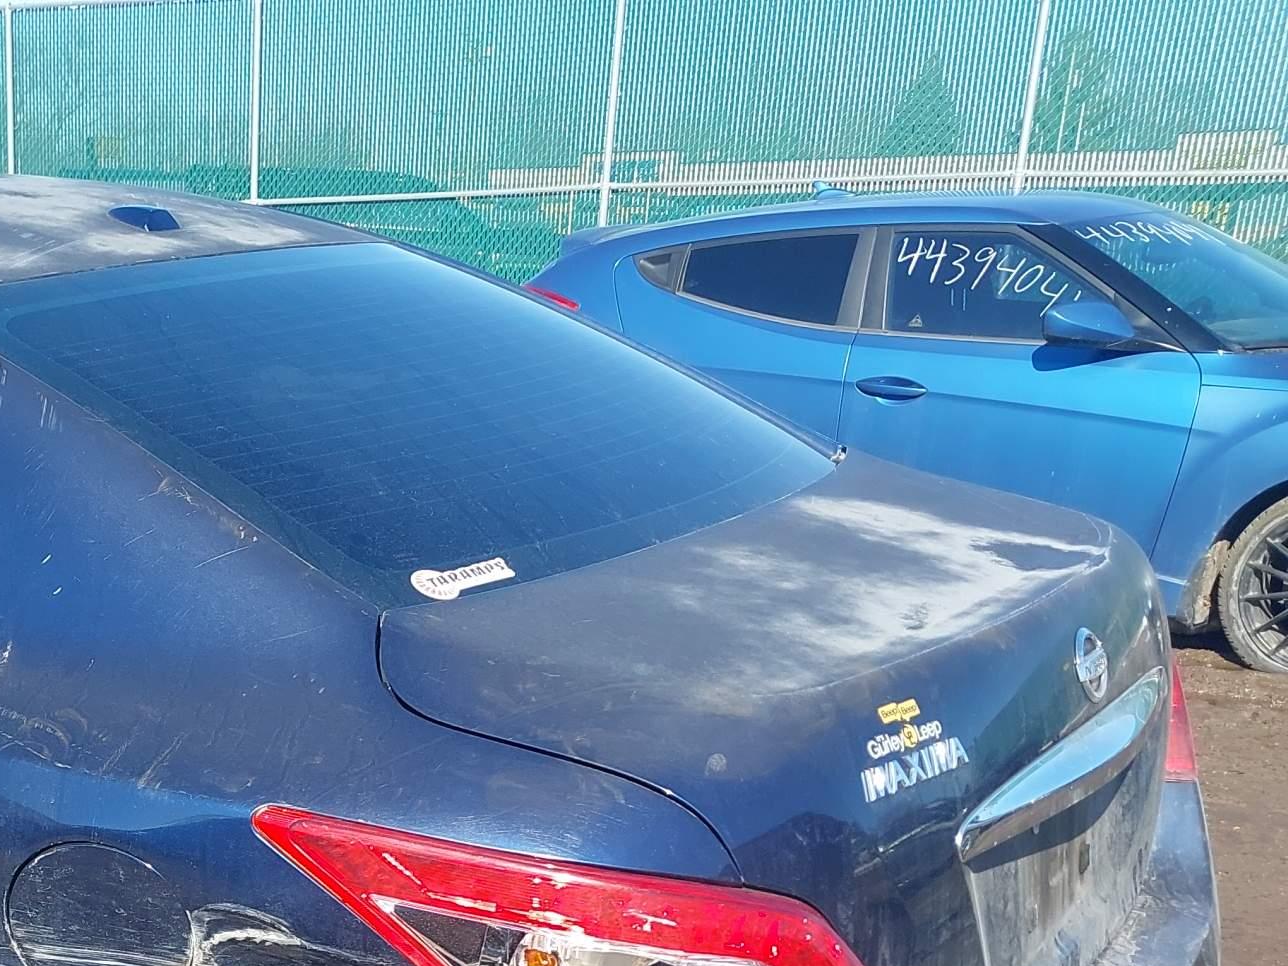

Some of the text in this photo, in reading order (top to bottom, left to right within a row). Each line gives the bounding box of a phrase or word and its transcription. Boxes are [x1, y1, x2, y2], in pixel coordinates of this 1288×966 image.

[880, 704, 917, 719] Beep Beep
[914, 720, 943, 742] Leep
[861, 737, 969, 802] MAXIMA
